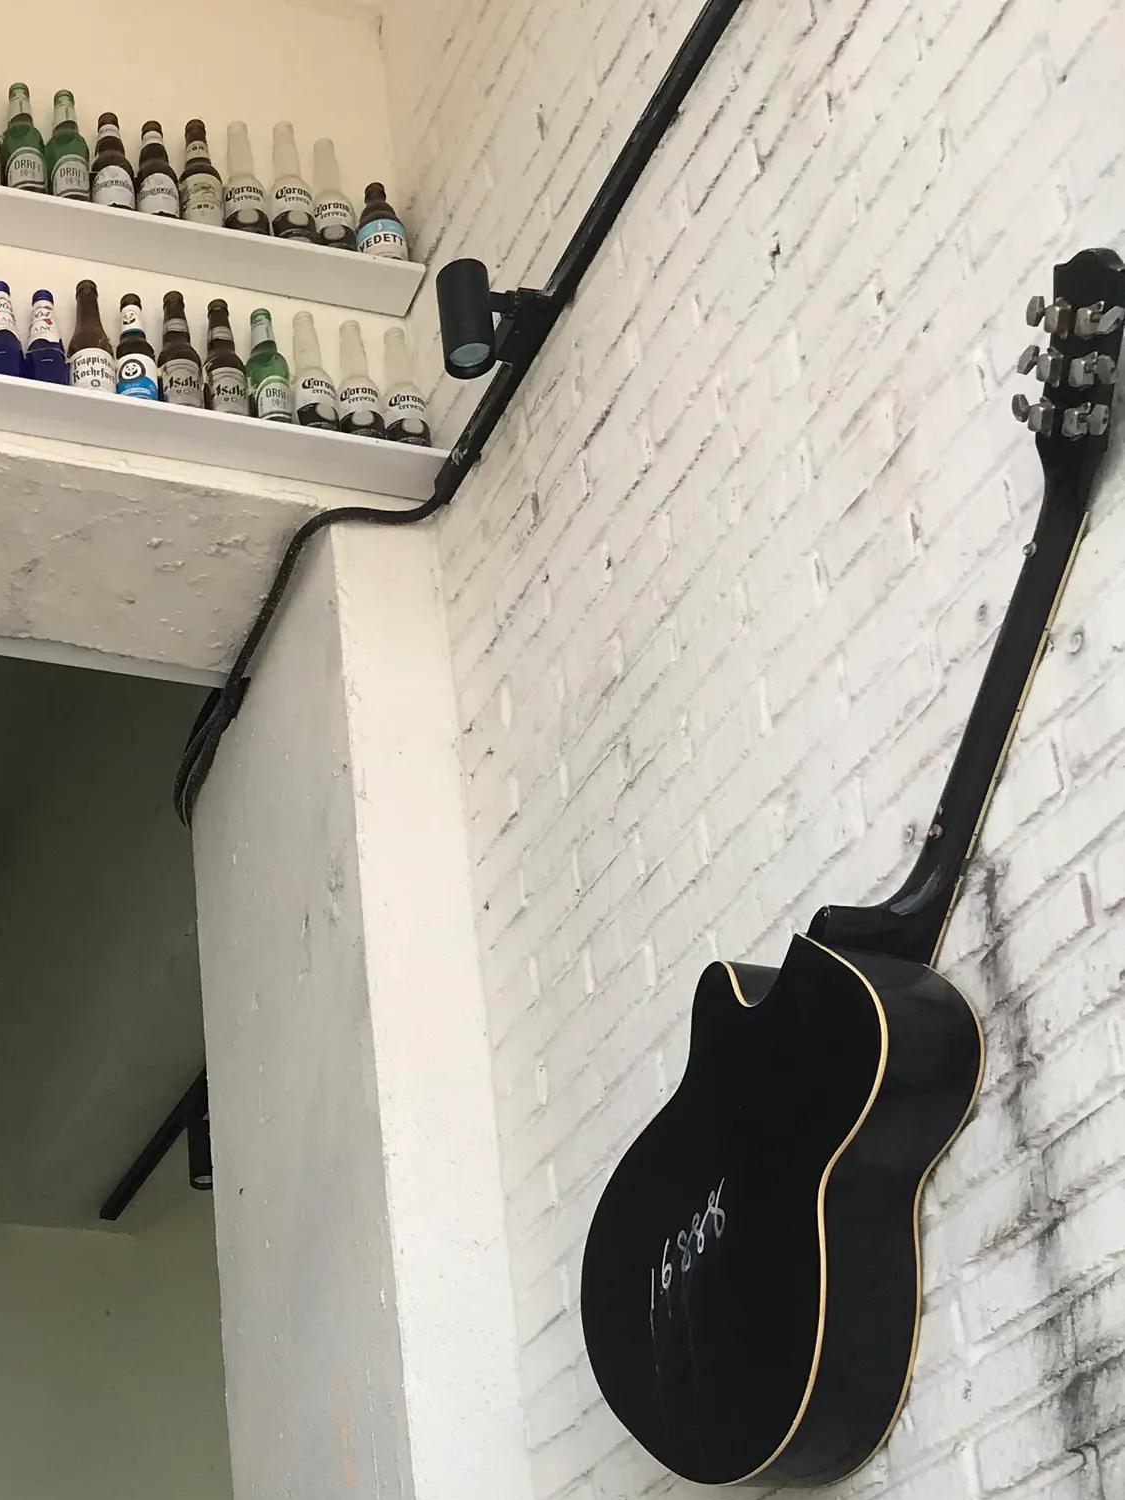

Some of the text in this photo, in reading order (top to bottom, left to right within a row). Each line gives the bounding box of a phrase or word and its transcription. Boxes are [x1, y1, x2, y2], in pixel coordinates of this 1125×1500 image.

[14, 158, 42, 173] DRAFT
[225, 185, 264, 201] Corona
[275, 185, 312, 200] Corona
[314, 202, 352, 218] Corona
[360, 232, 404, 253] VEDETT
[166, 375, 200, 391] Asahi
[340, 385, 379, 402] Corona
[388, 393, 427, 408] Corona
